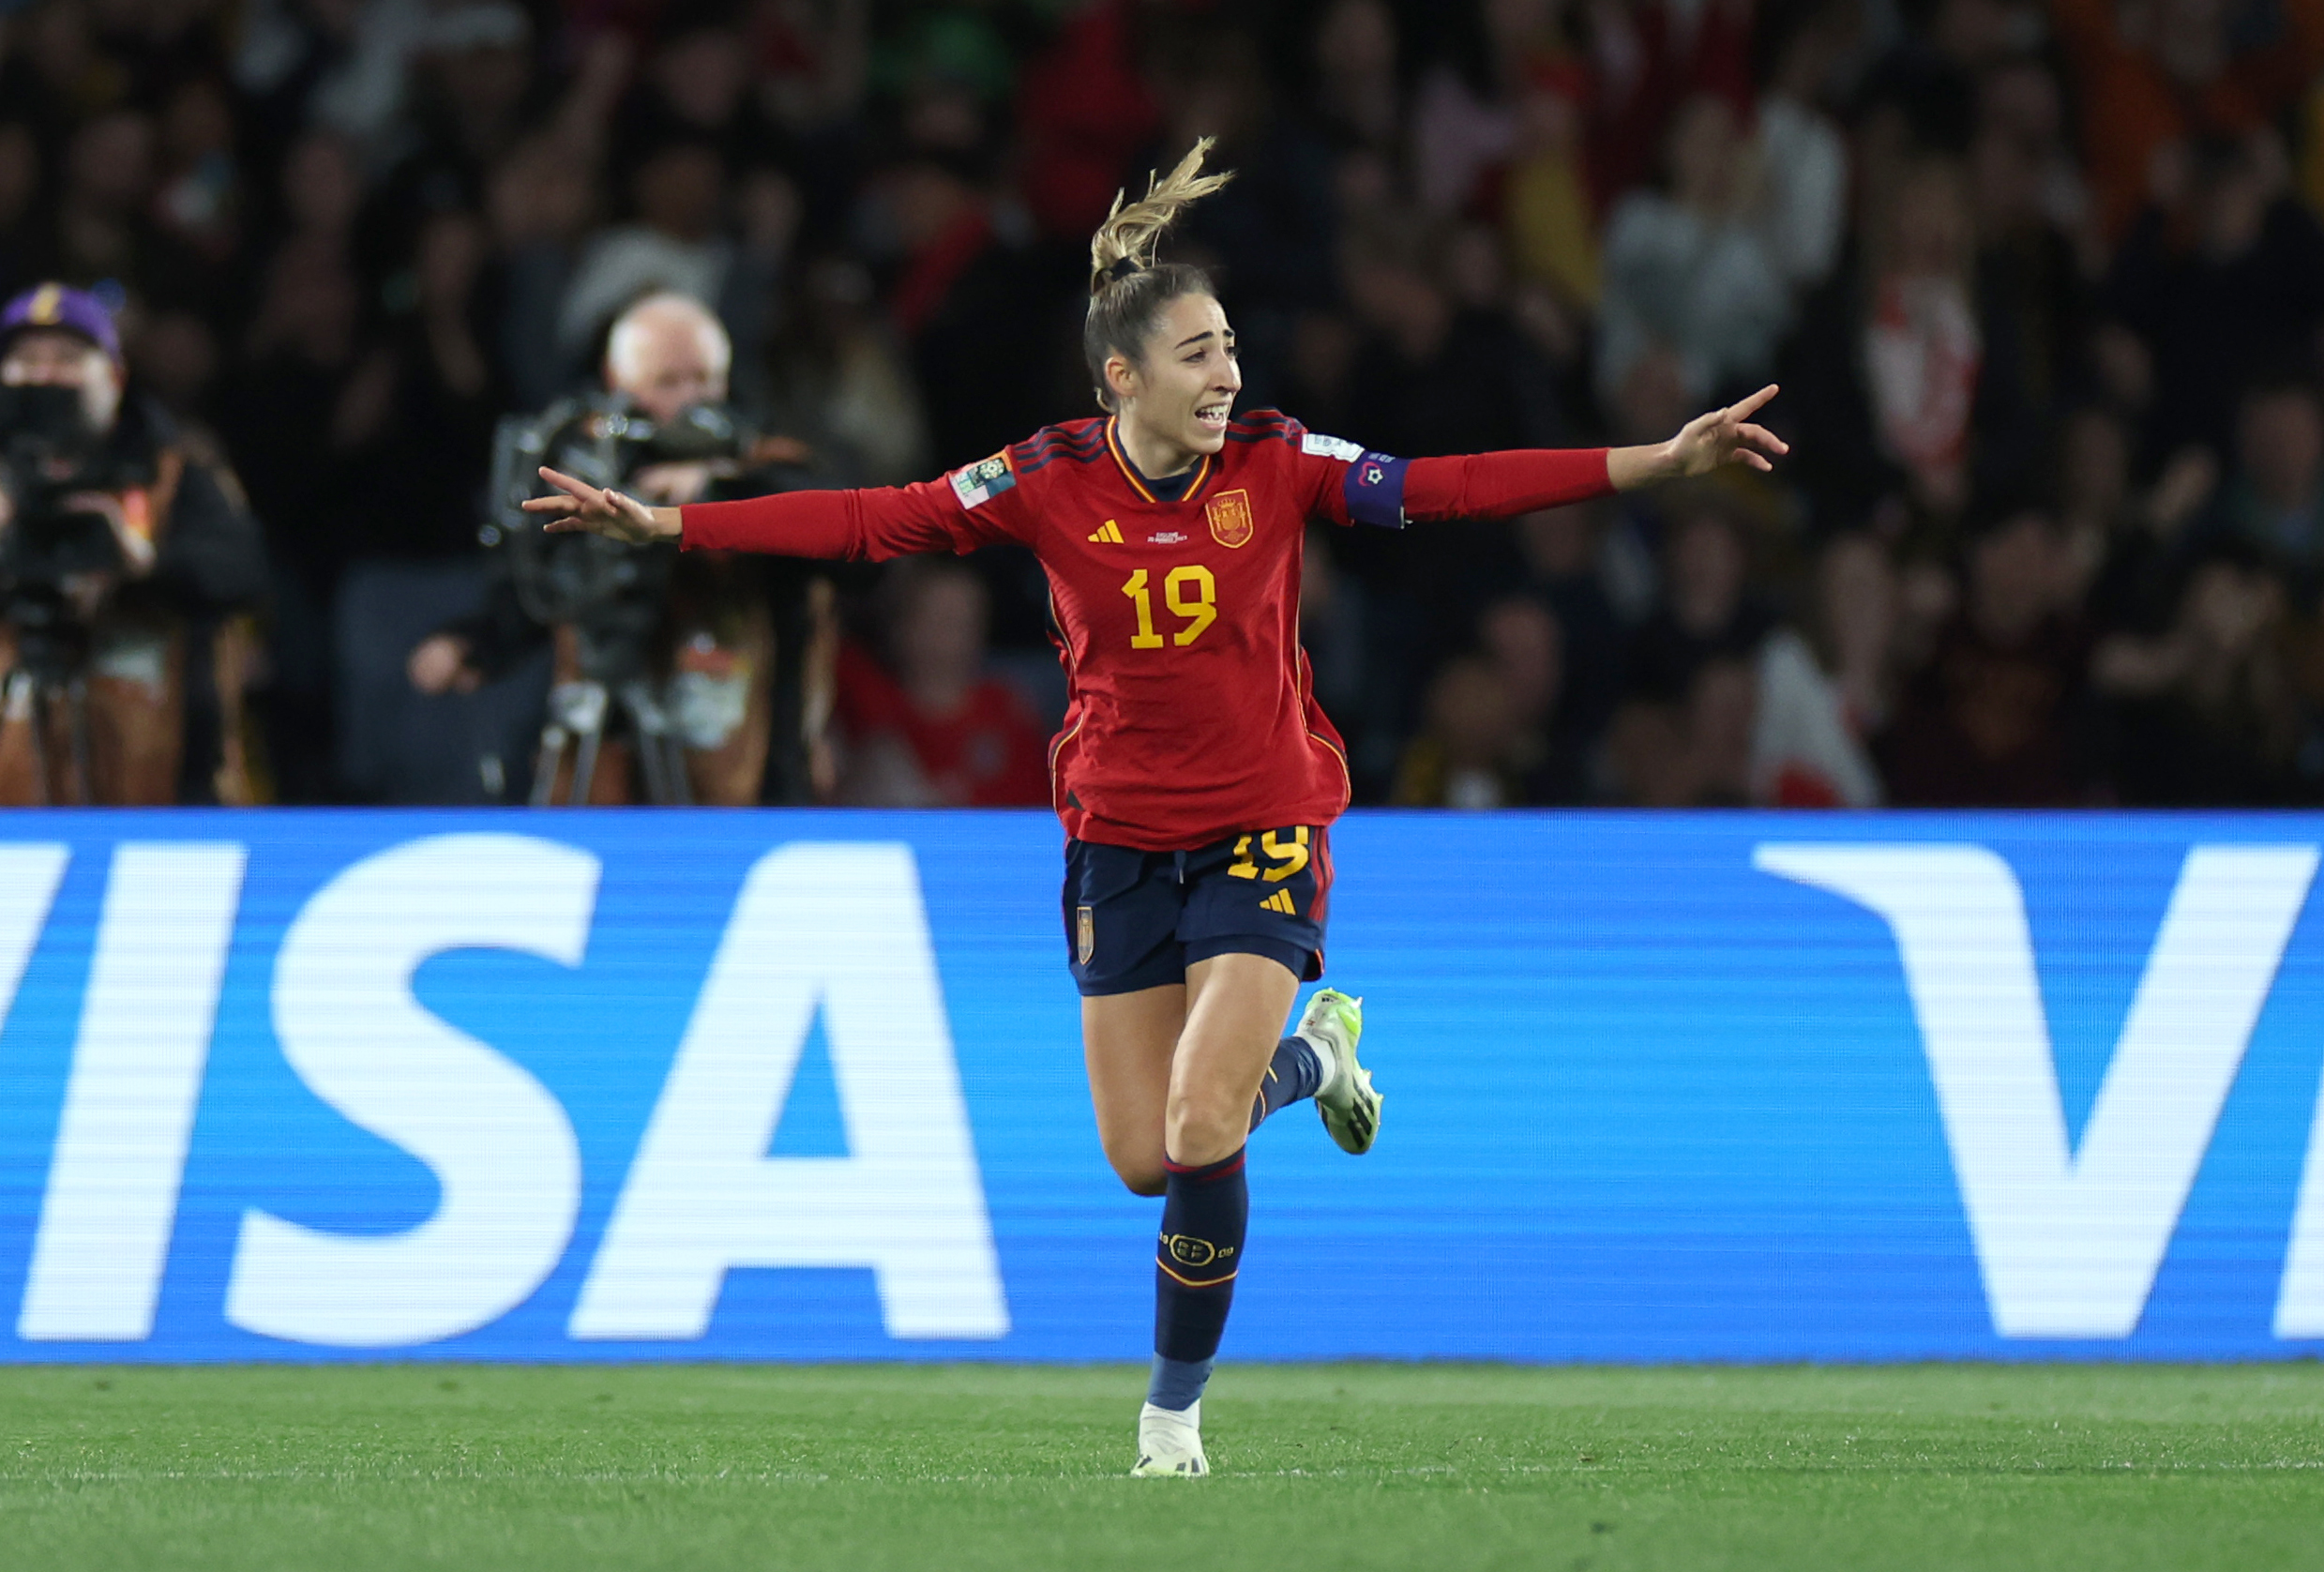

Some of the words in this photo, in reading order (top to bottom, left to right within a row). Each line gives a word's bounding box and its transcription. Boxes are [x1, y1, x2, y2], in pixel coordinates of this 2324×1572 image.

[1121, 565, 1217, 649] 19
[1227, 825, 1309, 883] 19
[1752, 842, 2324, 1339] V
